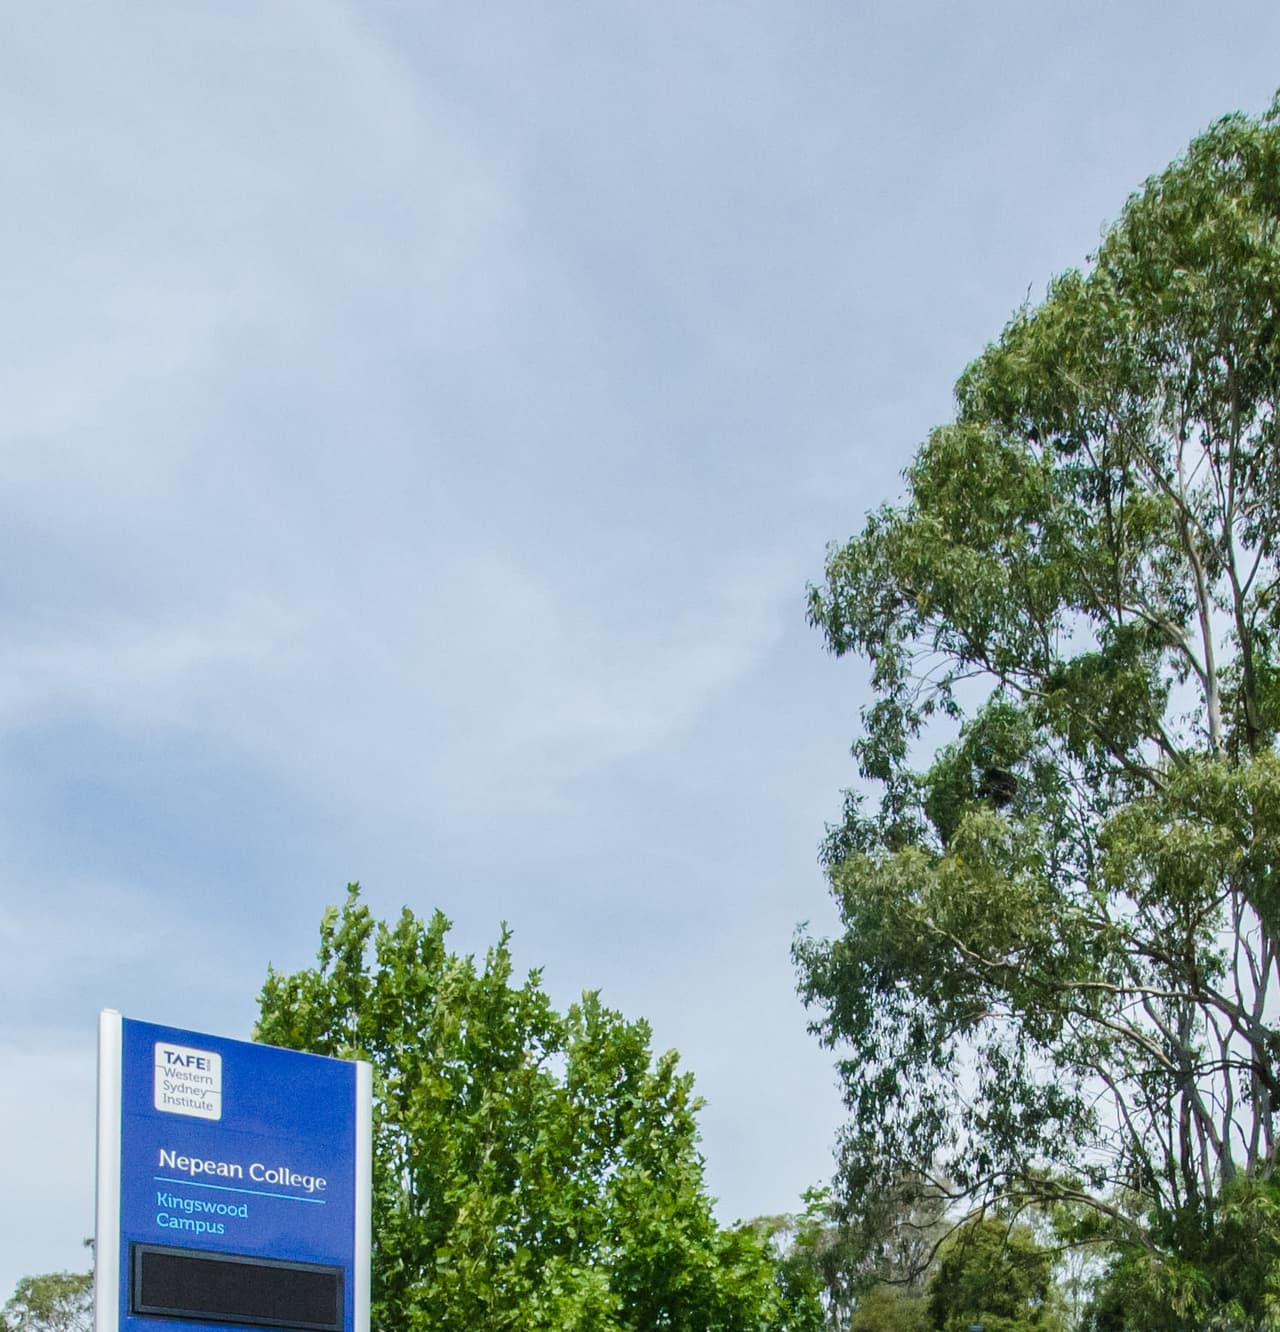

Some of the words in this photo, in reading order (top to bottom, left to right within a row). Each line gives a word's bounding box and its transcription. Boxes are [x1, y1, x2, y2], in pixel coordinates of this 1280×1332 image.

[163, 1050, 206, 1070] TAFE
[164, 1067, 213, 1085] Western
[163, 1079, 208, 1099] Sydney
[163, 1093, 213, 1111] Institute
[158, 1149, 244, 1180] Nepean
[249, 1163, 327, 1193] College
[157, 1191, 249, 1218] Kingswood
[156, 1213, 225, 1235] Campus
